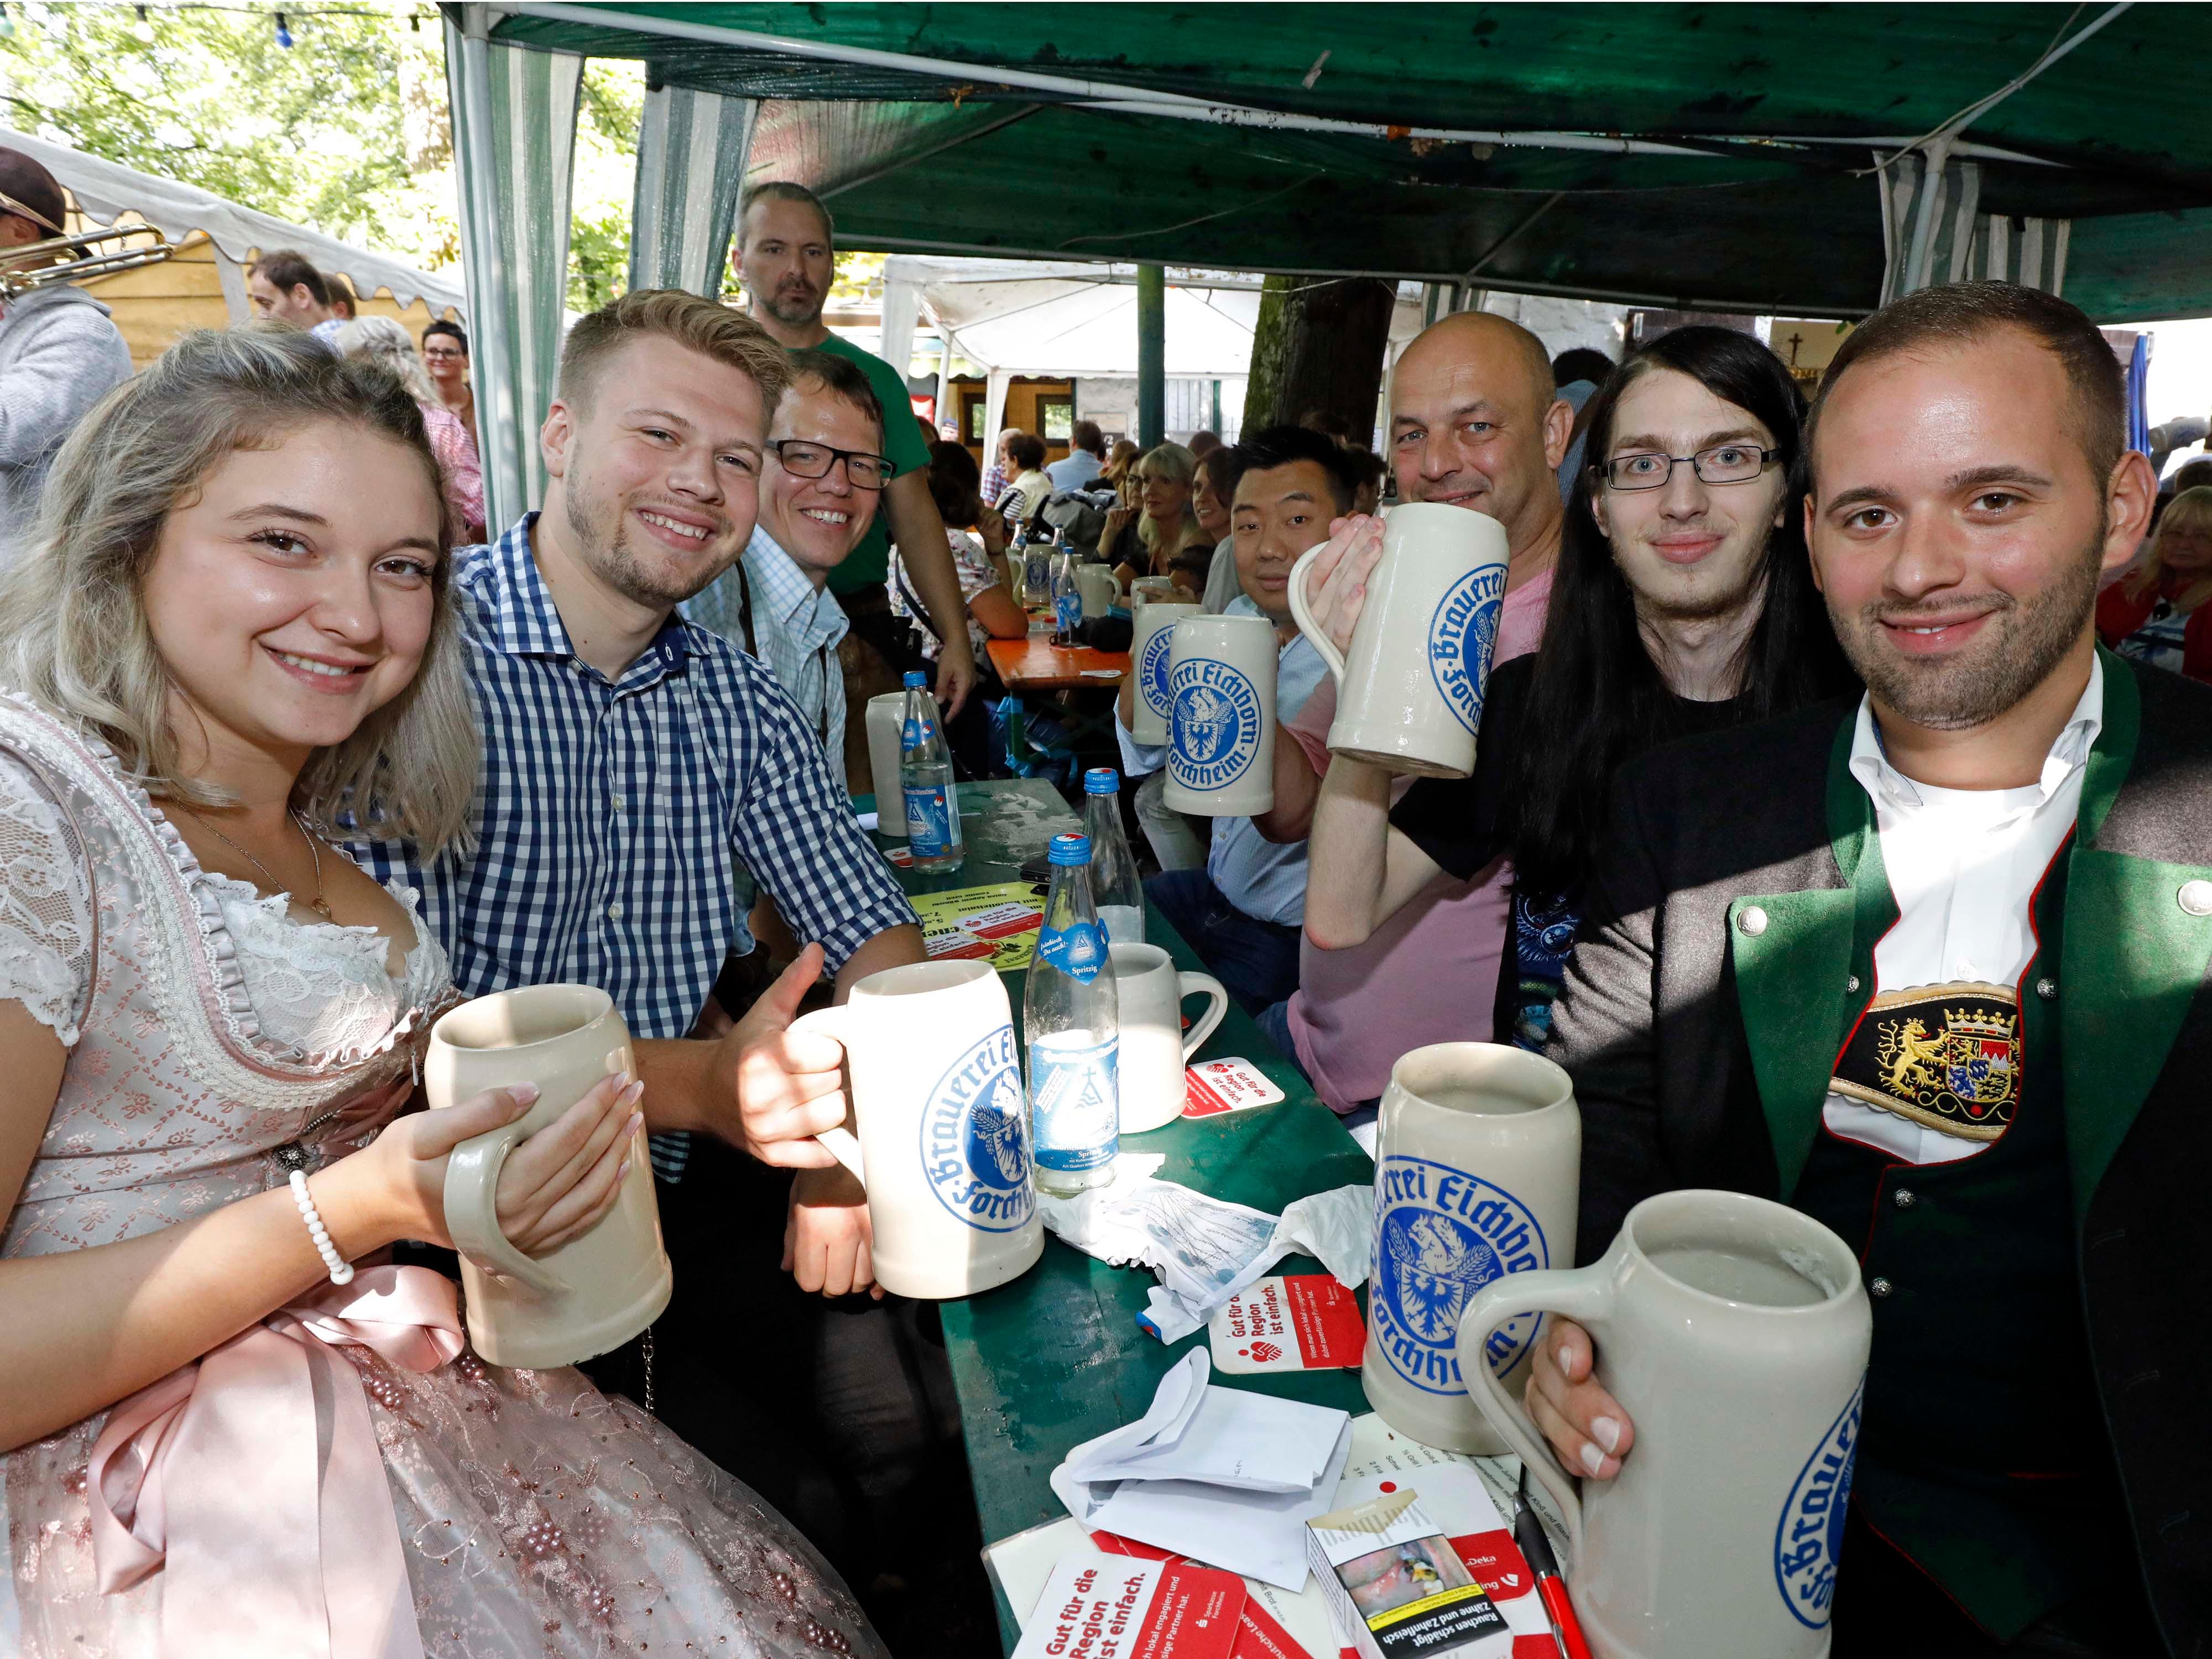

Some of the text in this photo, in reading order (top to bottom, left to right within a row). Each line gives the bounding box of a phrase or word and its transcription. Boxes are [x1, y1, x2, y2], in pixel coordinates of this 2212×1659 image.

[1432, 569, 1503, 660] Brauerei
[1202, 663, 1257, 744] Eichhorn
[1167, 744, 1247, 785] Forchheim
[983, 912, 1011, 922] Region
[926, 942, 950, 951] egion
[1043, 947, 1051, 957] Du
[1051, 941, 1066, 953] auch!
[1072, 966, 1098, 976] Spritzig
[1219, 1084, 1243, 1104] einfach.
[1224, 1074, 1245, 1092] Region
[1236, 1072, 1266, 1097] Gut für die
[929, 1041, 997, 1186] Brauerei
[1078, 1149, 1102, 1159] Spri
[1436, 1175, 1538, 1271] Eichho
[1228, 1304, 1243, 1319] für
[1248, 1303, 1266, 1337] Region
[1261, 1284, 1284, 1335] ist einfach.
[1293, 1282, 1317, 1359] Wenn man sich lokal engagiert und
[1231, 1318, 1246, 1337] Gut
[1307, 1290, 1330, 1358] dabei zuverlässige Partner hat.
[1321, 1502, 1433, 1547] Marlboro
[1493, 1499, 1514, 1524] Kloß und
[1531, 1498, 1546, 1511] Kloß
[1543, 1511, 1557, 1523] und
[1469, 1556, 1496, 1566] Deka
[1046, 1569, 1098, 1655] Gut für die
[1108, 1573, 1146, 1636] einfach.
[1204, 1590, 1217, 1618] Sparkasse
[1212, 1591, 1226, 1619] Forchheim
[1264, 1591, 1277, 1605] Brot
[1459, 1601, 1491, 1618] Zähne
[1145, 1631, 1161, 1653] lokal
[1155, 1592, 1175, 1631] engagiert
[1168, 1575, 1181, 1592] und
[1166, 1610, 1185, 1640] Partner
[1181, 1594, 1191, 1609] hat.
[1439, 1610, 1459, 1623] und
[1068, 1601, 1109, 1659] Region
[1383, 1619, 1440, 1644] Zahnfleisch
[1412, 1613, 1499, 1647] Rauchen schädigt
[1256, 1630, 1287, 1659] eutsche
